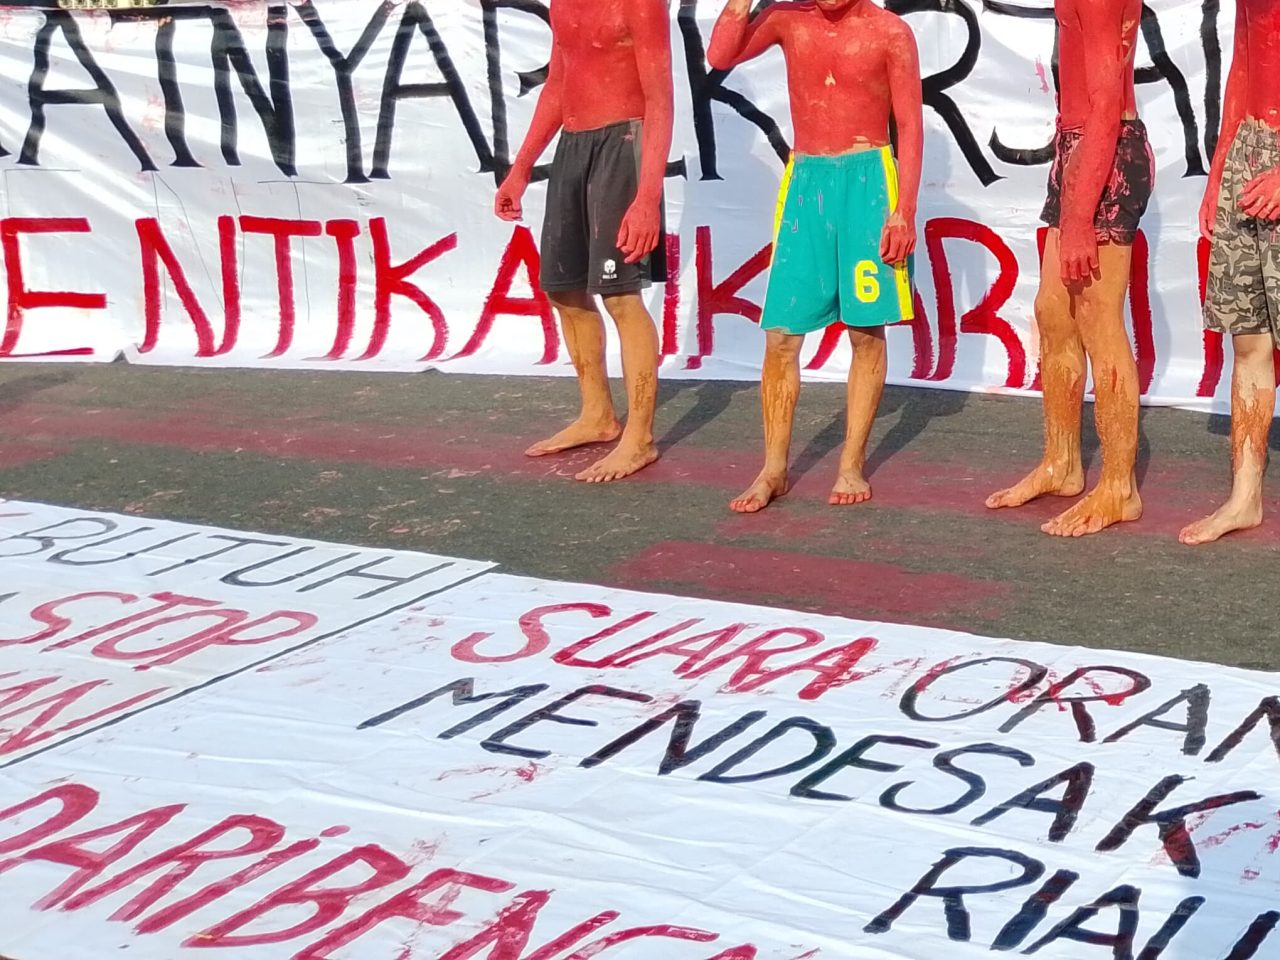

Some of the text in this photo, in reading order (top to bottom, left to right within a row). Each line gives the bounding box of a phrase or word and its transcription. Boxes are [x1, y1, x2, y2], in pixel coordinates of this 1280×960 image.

[854, 259, 881, 304] 6
[0, 591, 319, 672] STOP
[451, 602, 880, 700] SUARA
[356, 677, 1264, 878] MENDESAK
